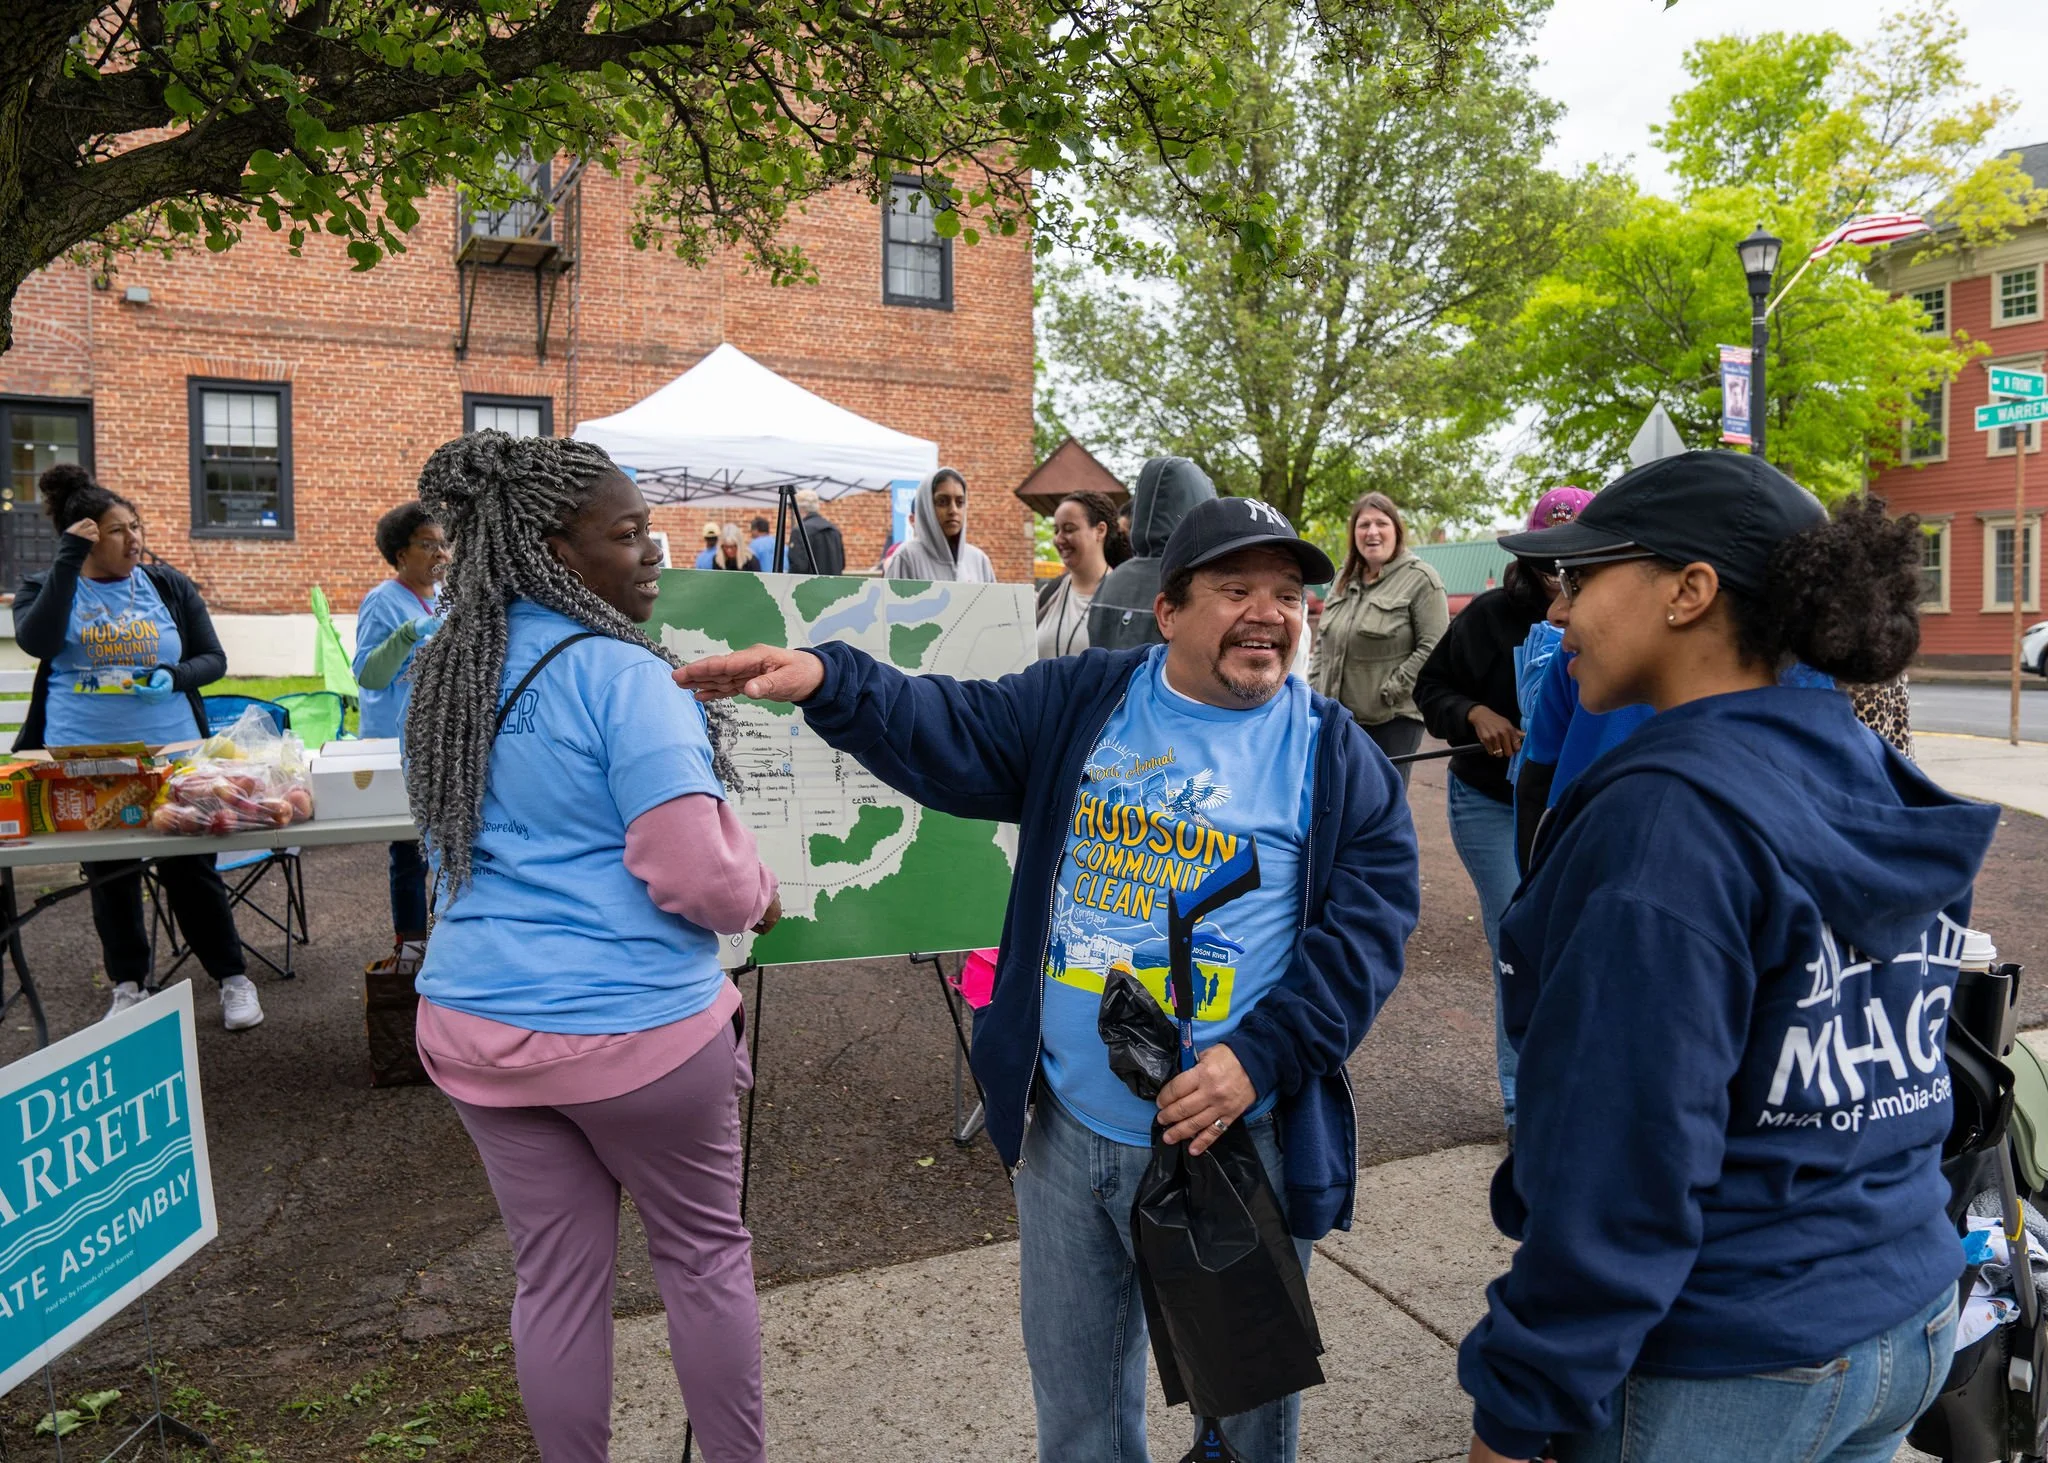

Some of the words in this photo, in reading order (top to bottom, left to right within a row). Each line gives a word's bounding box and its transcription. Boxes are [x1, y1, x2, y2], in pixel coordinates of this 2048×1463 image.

[1244, 498, 1286, 528] NY
[81, 620, 159, 645] HUDSON
[87, 640, 159, 658] COMMUNITY
[69, 787, 83, 820] SALTY
[1073, 791, 1238, 866] HUDSON
[1072, 839, 1216, 892] COMMUNIT
[1211, 950, 1227, 960] RIVER
[16, 1055, 117, 1144] Didi
[1756, 1109, 1823, 1129] MHA
[60, 1167, 191, 1284] ASSEMBLY
[76, 1276, 98, 1293] Friends
[104, 1262, 116, 1274] Didi
[116, 1249, 135, 1266] Barrett
